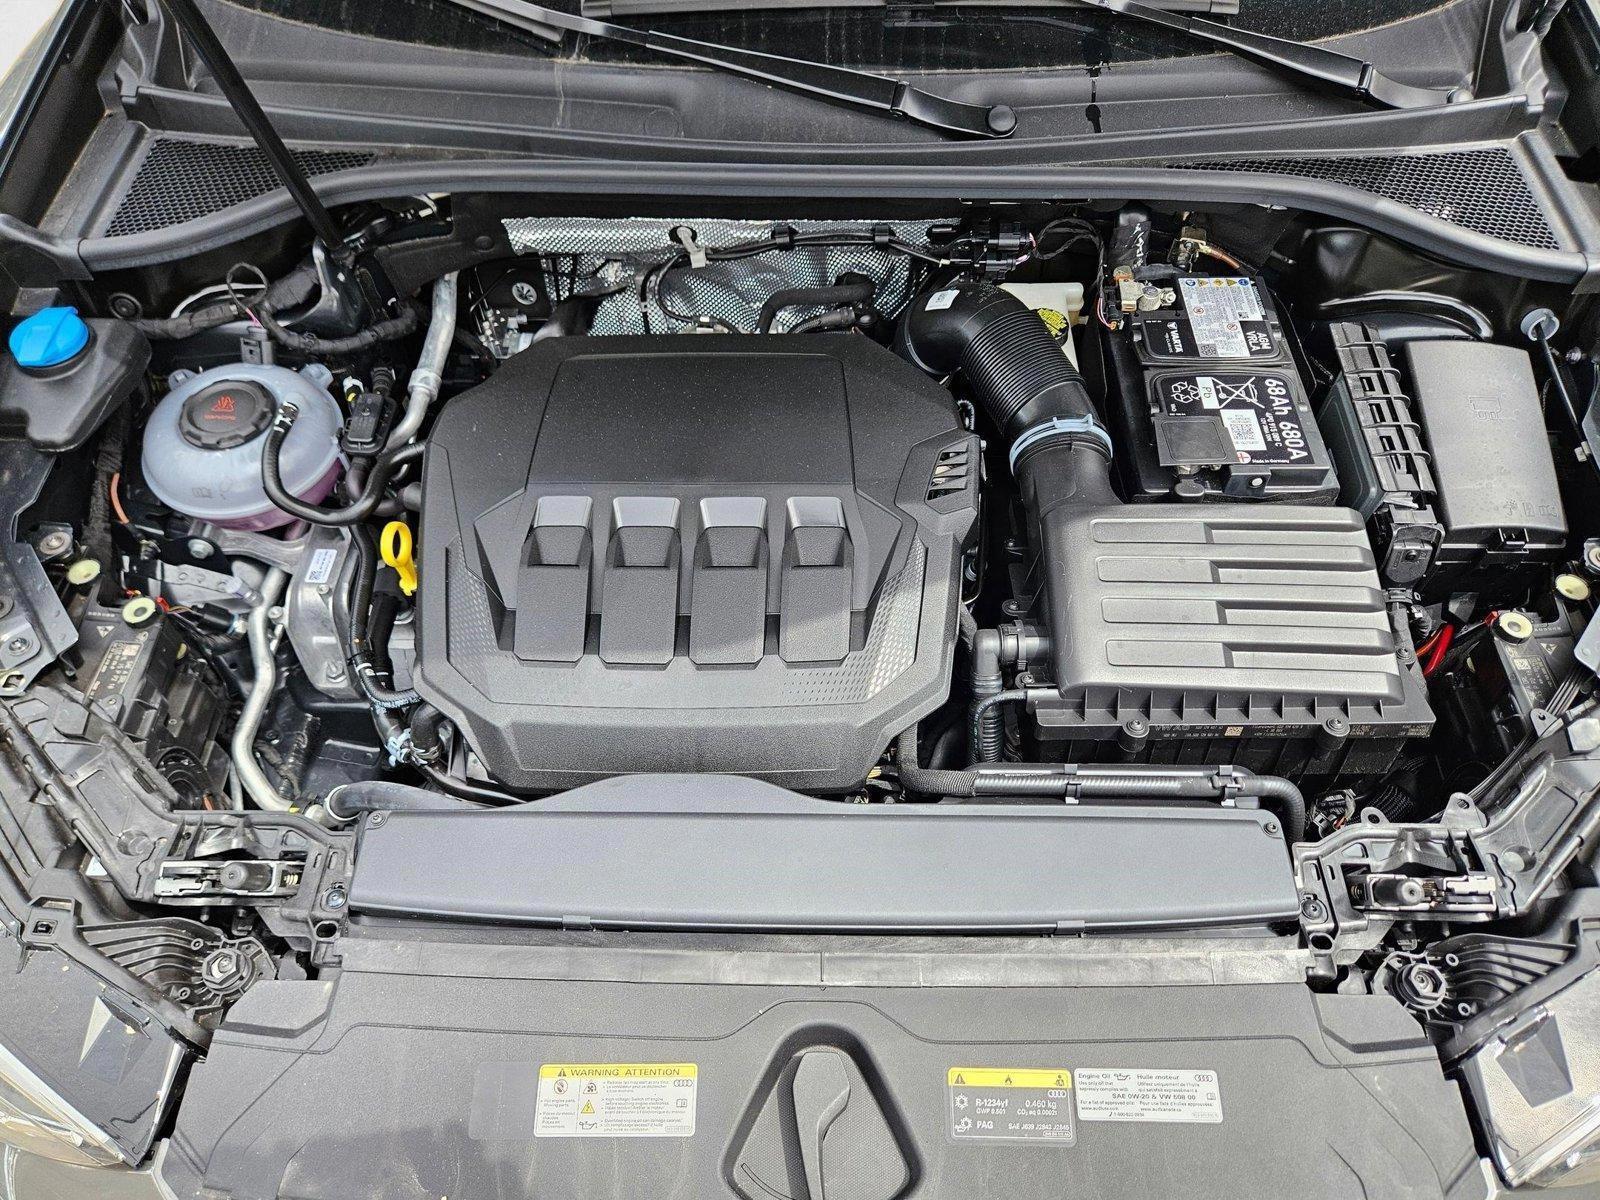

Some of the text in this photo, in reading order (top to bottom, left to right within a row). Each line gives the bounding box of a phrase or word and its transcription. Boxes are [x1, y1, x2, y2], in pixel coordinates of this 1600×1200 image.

[1171, 330, 1183, 353] VARTA
[1246, 331, 1260, 352] VRLA
[1257, 332, 1272, 350] AGM
[1202, 387, 1213, 399] Pb
[1265, 379, 1308, 460] 68Ah 680A
[625, 1068, 680, 1076] ATTENTION
[975, 1098, 1056, 1109] R-1234yf 0.460 kg
[977, 1120, 993, 1129] PAG
